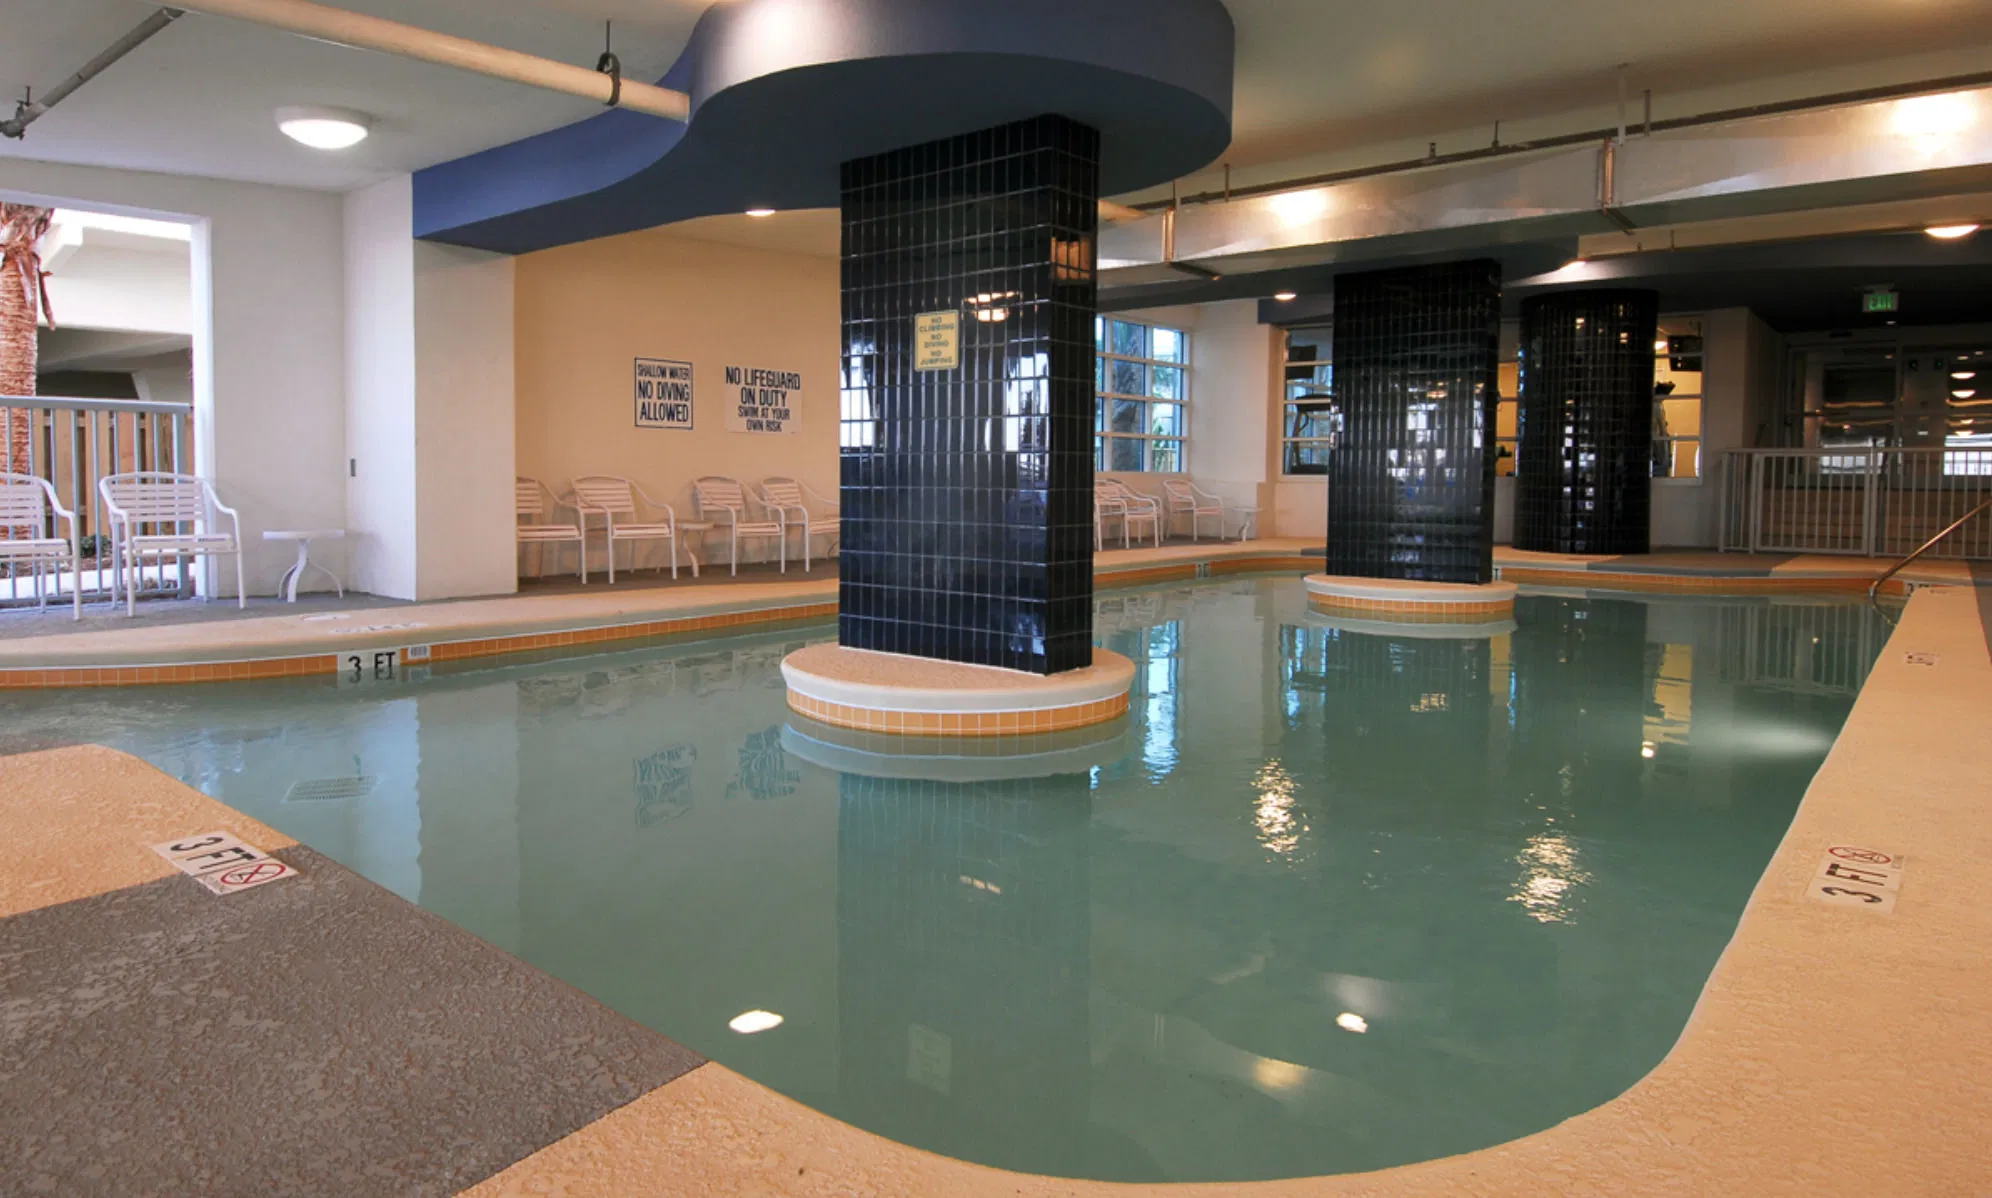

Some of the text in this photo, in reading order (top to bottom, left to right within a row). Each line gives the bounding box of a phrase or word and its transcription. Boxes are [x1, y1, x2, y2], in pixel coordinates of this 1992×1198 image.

[638, 363, 690, 380] SHALLOW WATER
[725, 366, 801, 390] NO LIFEGUARD
[638, 380, 690, 401] NO DIVING
[741, 387, 787, 407] ON DUTY
[640, 402, 689, 422] ALLOWED
[738, 406, 790, 420] SWIM AT YOUR
[746, 419, 782, 432] OWN RISK
[347, 655, 361, 676] 3
[374, 651, 396, 673] FT
[170, 837, 257, 870] 3 FT
[1821, 863, 1889, 903] 3 FT
